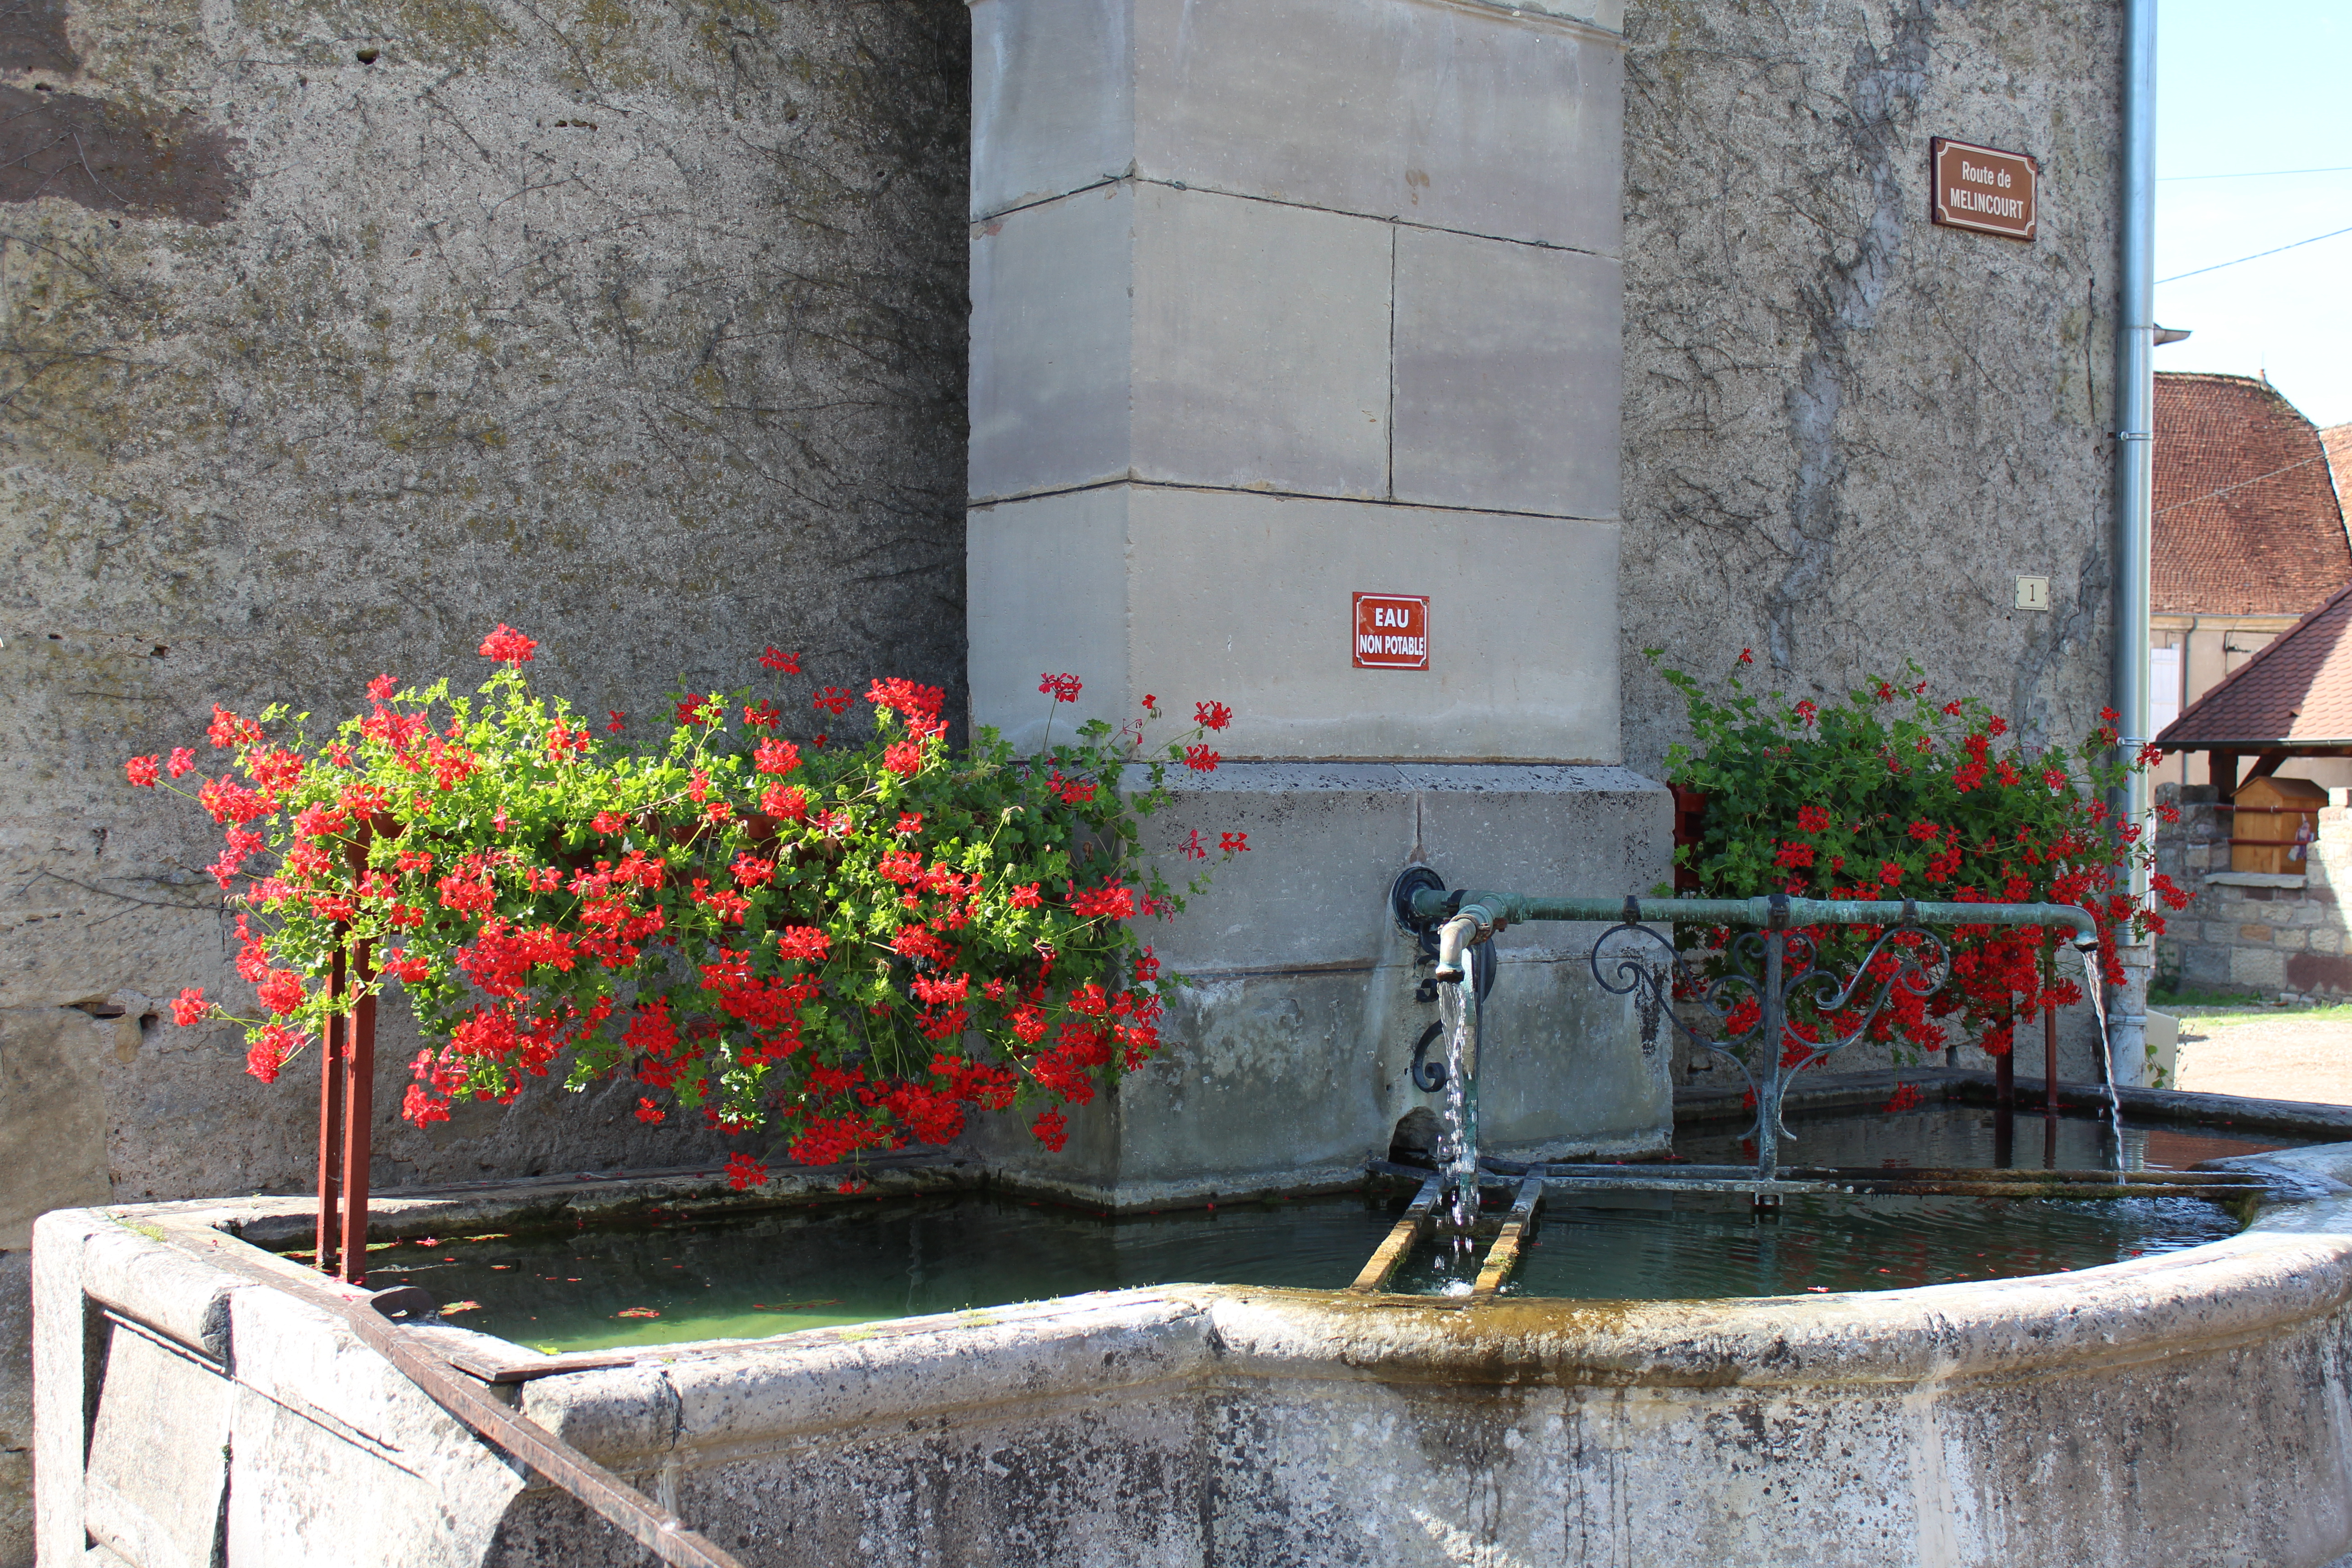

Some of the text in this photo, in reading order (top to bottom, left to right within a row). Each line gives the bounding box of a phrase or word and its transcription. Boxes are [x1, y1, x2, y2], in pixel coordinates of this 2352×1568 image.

[1962, 161, 2011, 188] Route de
[1950, 187, 2024, 219] MELINCOURT
[2030, 583, 2035, 602] 1
[1375, 608, 1409, 628] EAU
[1360, 634, 1424, 656] NON POTABLE
